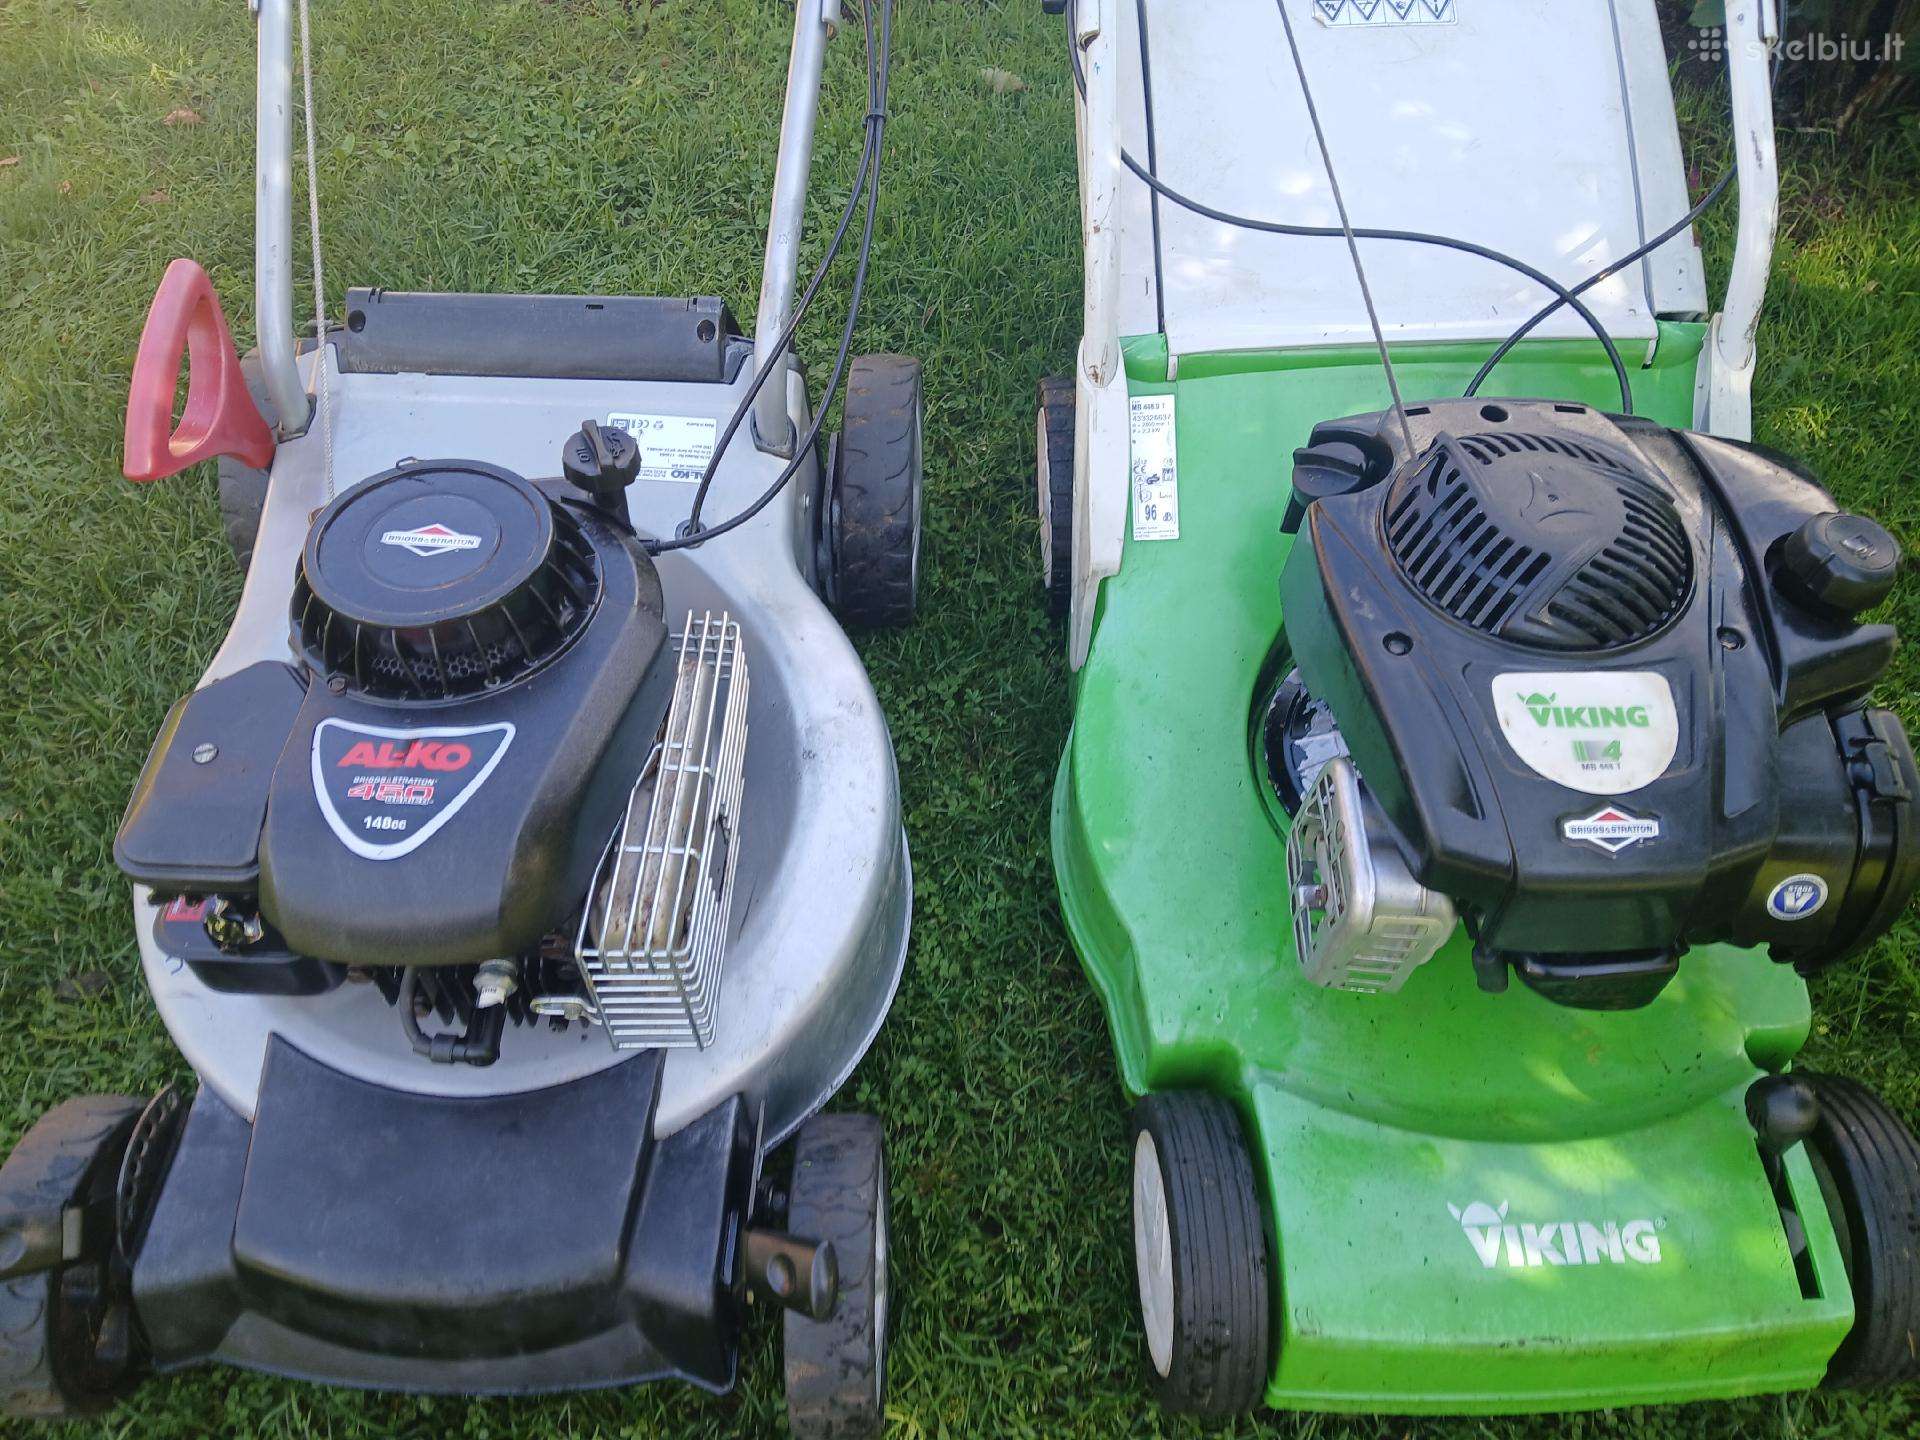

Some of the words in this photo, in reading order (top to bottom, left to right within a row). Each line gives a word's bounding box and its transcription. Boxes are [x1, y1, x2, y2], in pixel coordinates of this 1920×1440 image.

[1145, 504, 1157, 520] 96
[1527, 706, 1650, 728] VIKING
[336, 741, 472, 771] AL-KO
[348, 784, 434, 801] 450
[1462, 1220, 1662, 1268] VIKING
